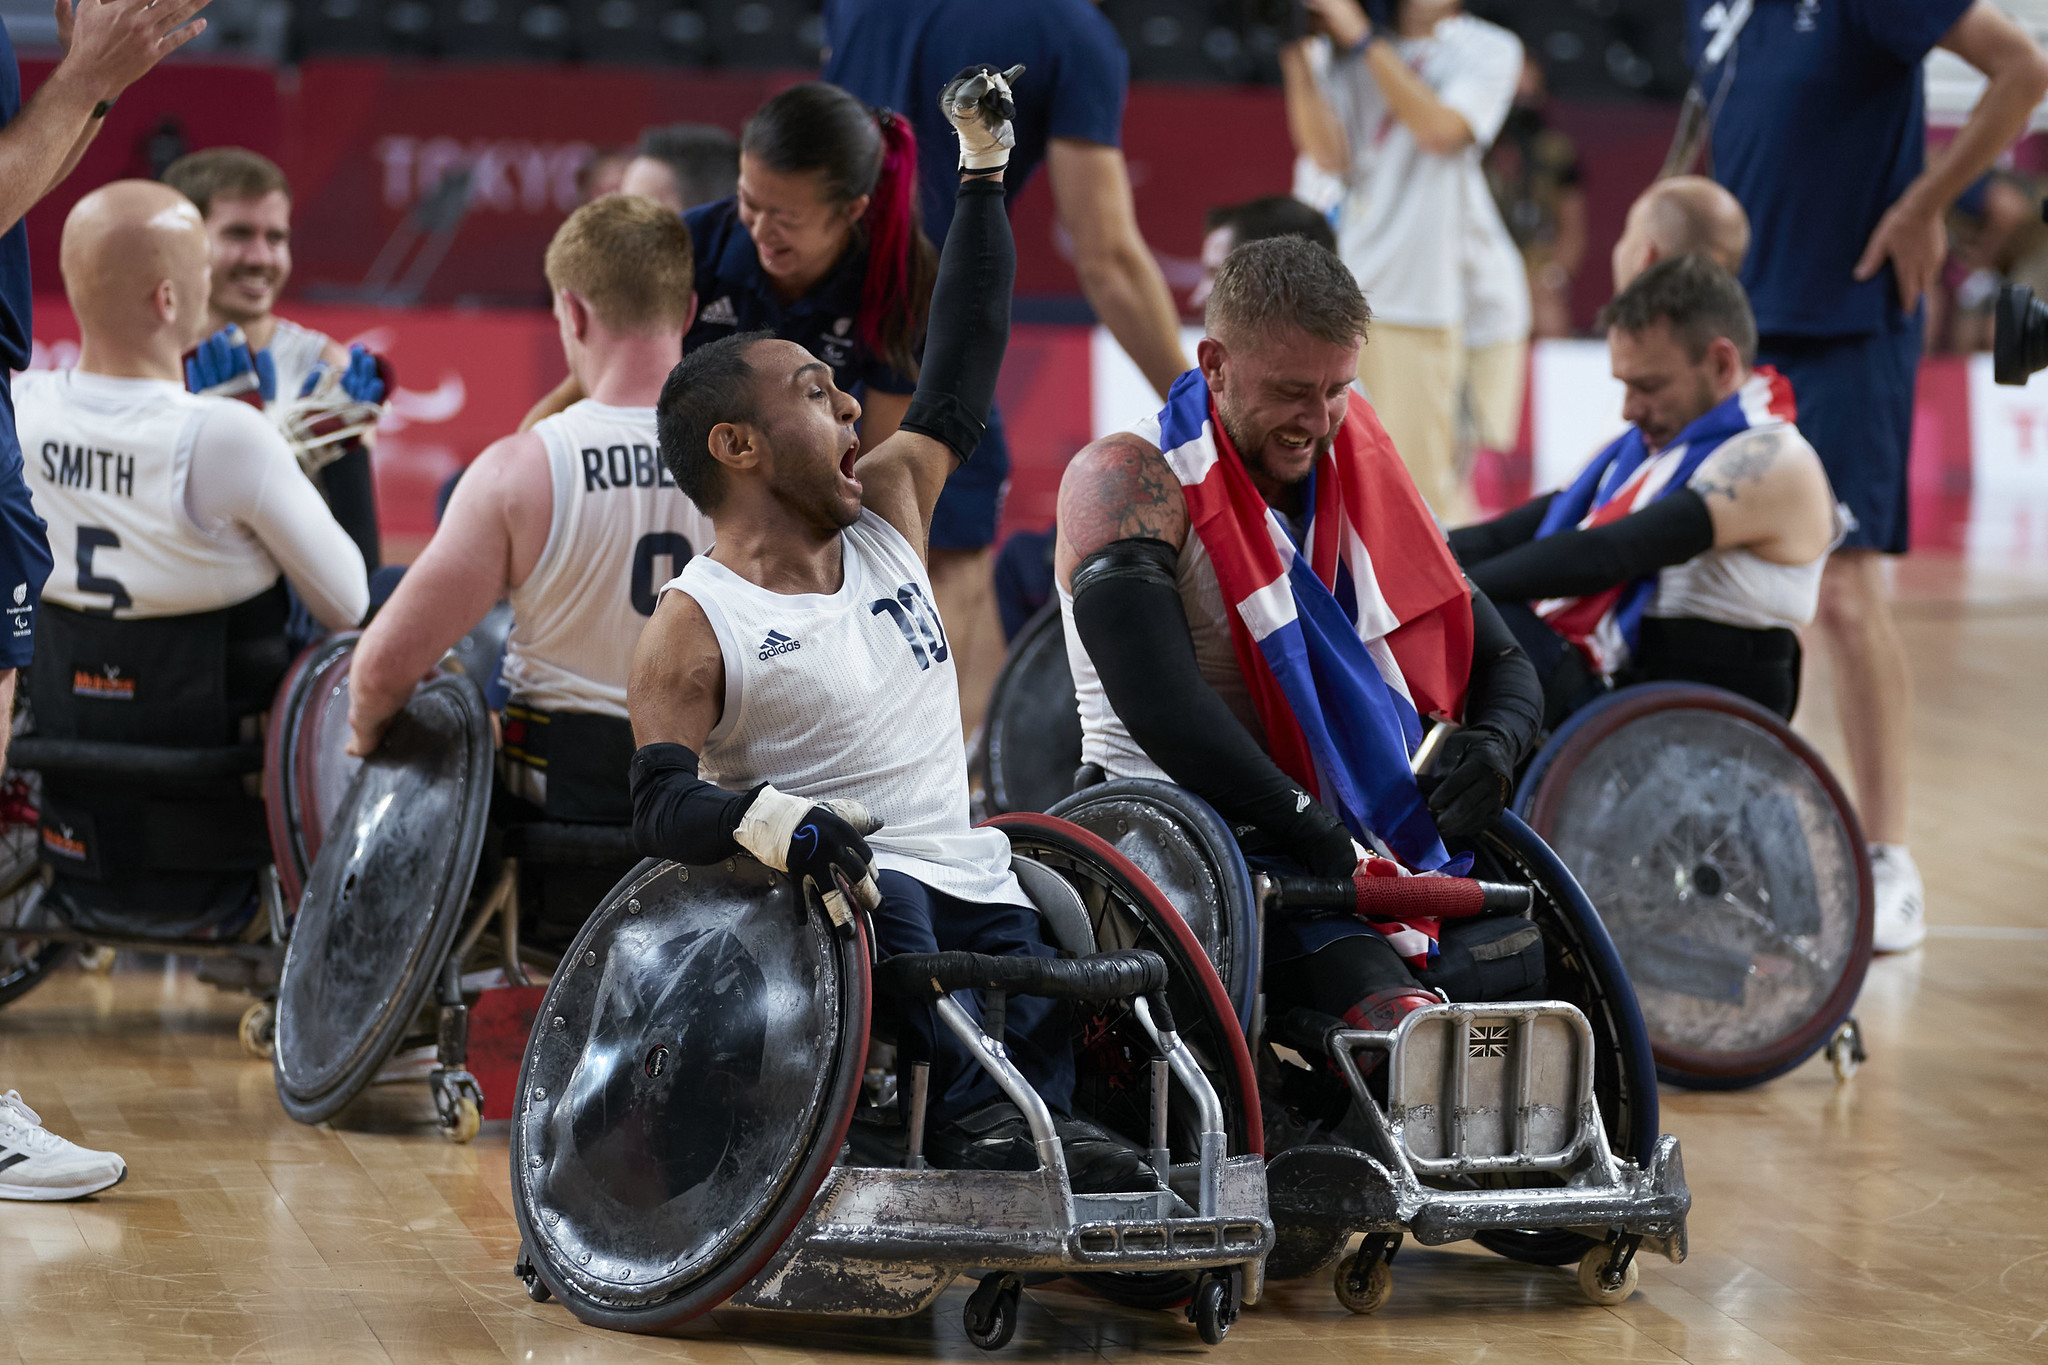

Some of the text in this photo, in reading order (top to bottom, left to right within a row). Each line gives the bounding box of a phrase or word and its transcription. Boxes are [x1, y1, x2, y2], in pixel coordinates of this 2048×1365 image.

[41, 441, 135, 498] SMITH
[582, 444, 676, 492] ROBE
[76, 525, 133, 620] 5
[758, 638, 801, 662] adidas
[866, 582, 949, 671] 10
